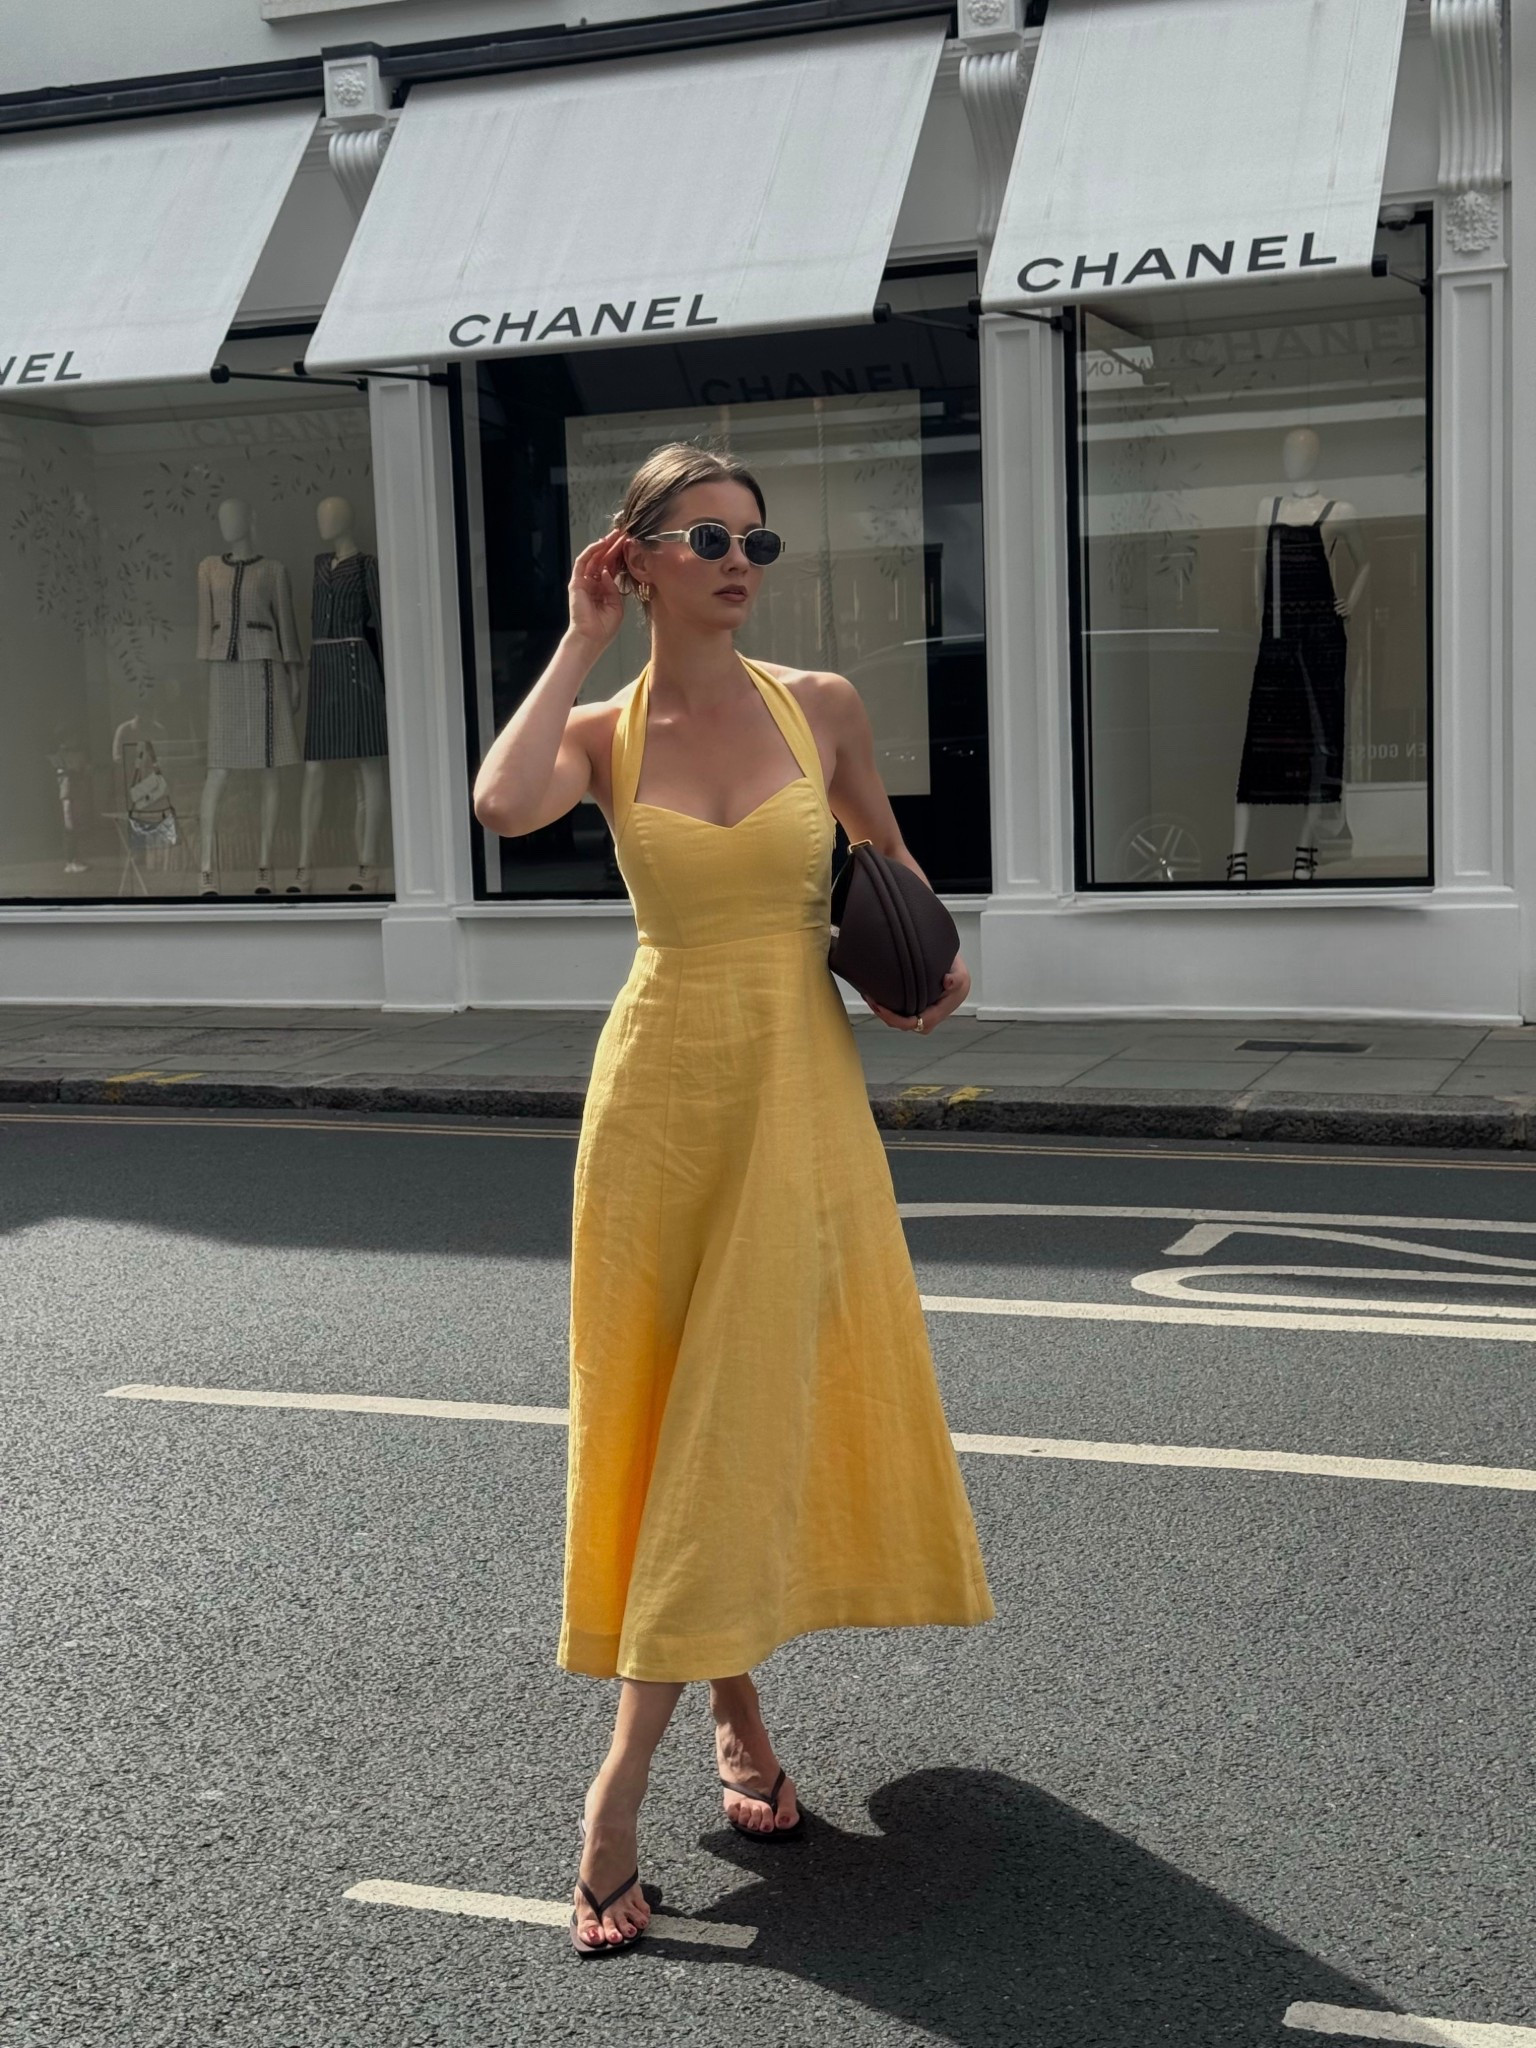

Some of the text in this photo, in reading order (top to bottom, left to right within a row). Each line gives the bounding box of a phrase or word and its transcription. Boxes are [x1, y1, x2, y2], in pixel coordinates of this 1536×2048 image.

[1016, 231, 1338, 293] CHANEL
[448, 293, 719, 348] CHANEL
[700, 361, 938, 405] CHANEL
[192, 408, 368, 446] CHANE
